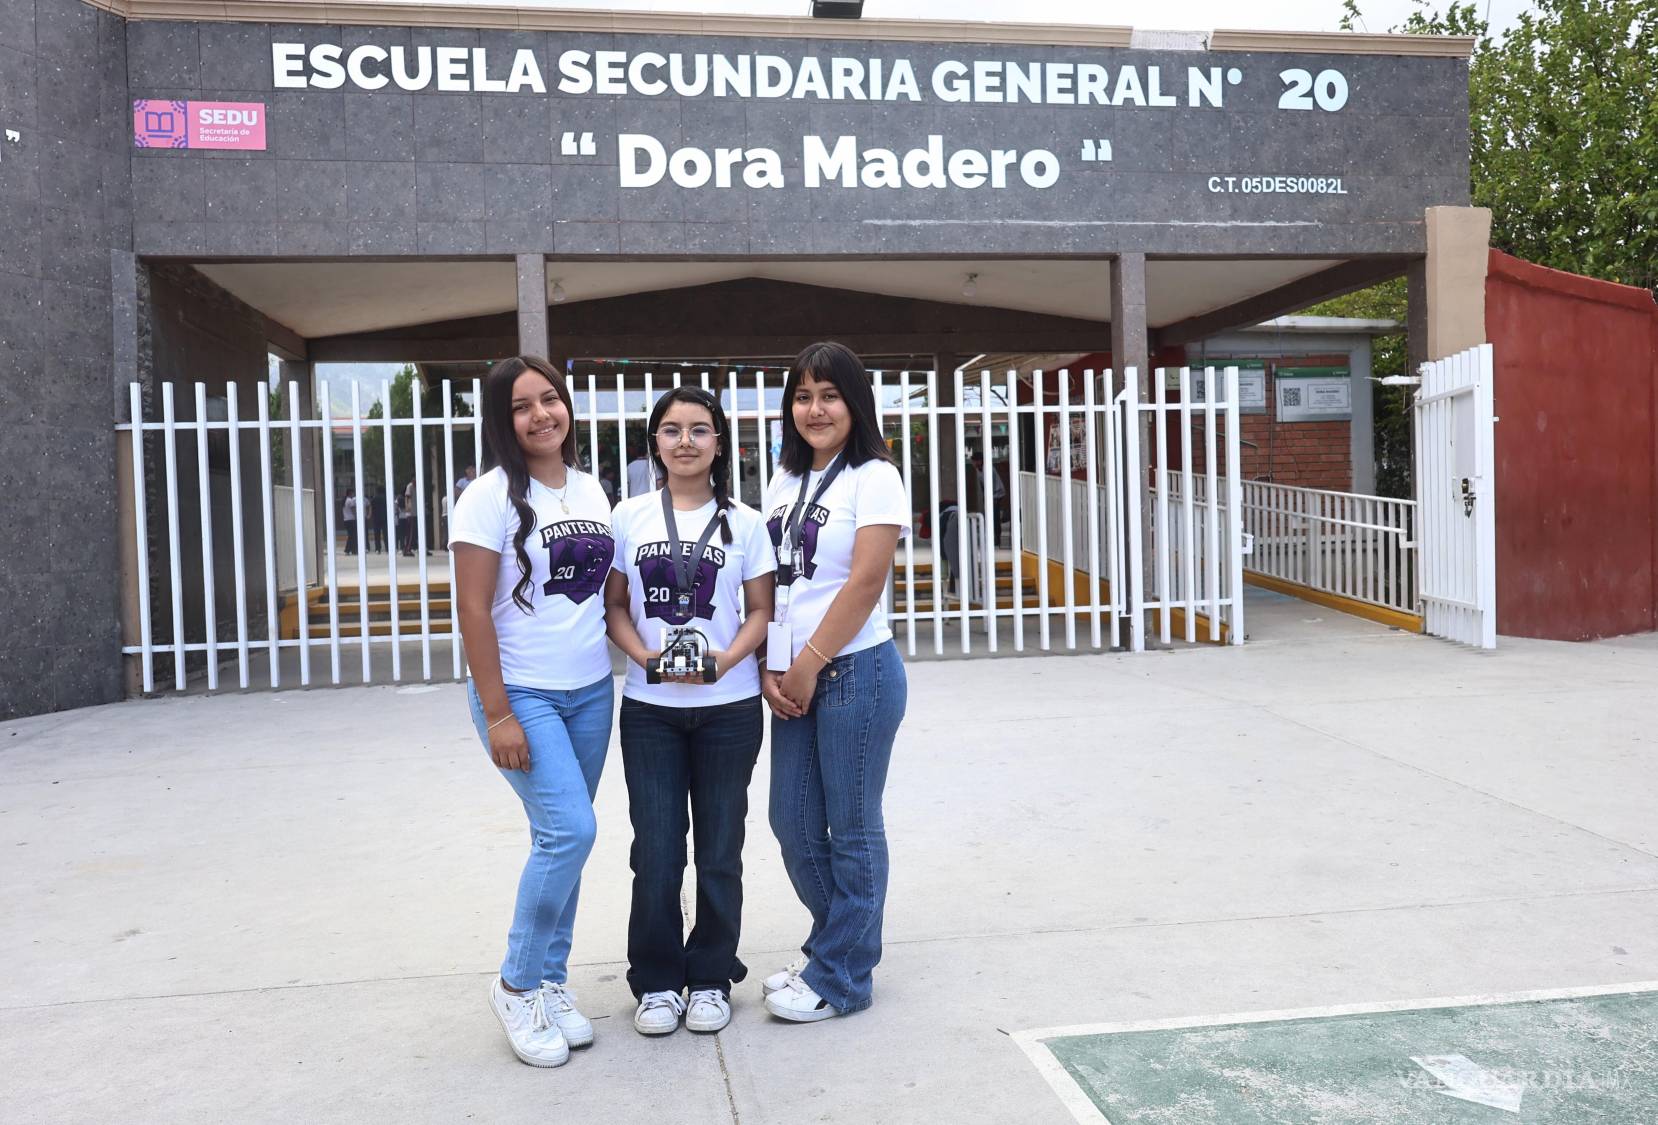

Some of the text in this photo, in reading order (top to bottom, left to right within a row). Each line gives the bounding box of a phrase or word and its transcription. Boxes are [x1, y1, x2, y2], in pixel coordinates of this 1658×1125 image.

[273, 42, 547, 93] ESCUELA
[557, 49, 922, 102] SECUNDARIA
[932, 60, 1177, 107] GENERAL
[1278, 69, 1349, 111] 20
[199, 109, 257, 126] SEDU
[199, 134, 240, 143] Educación
[240, 128, 250, 136] de
[618, 133, 785, 189] Dora
[803, 135, 1061, 189] Madero
[1207, 176, 1348, 194] C.T. 05DES0082L
[638, 542, 724, 566] PANEAS
[553, 565, 576, 580] 20
[648, 587, 670, 602] 20
